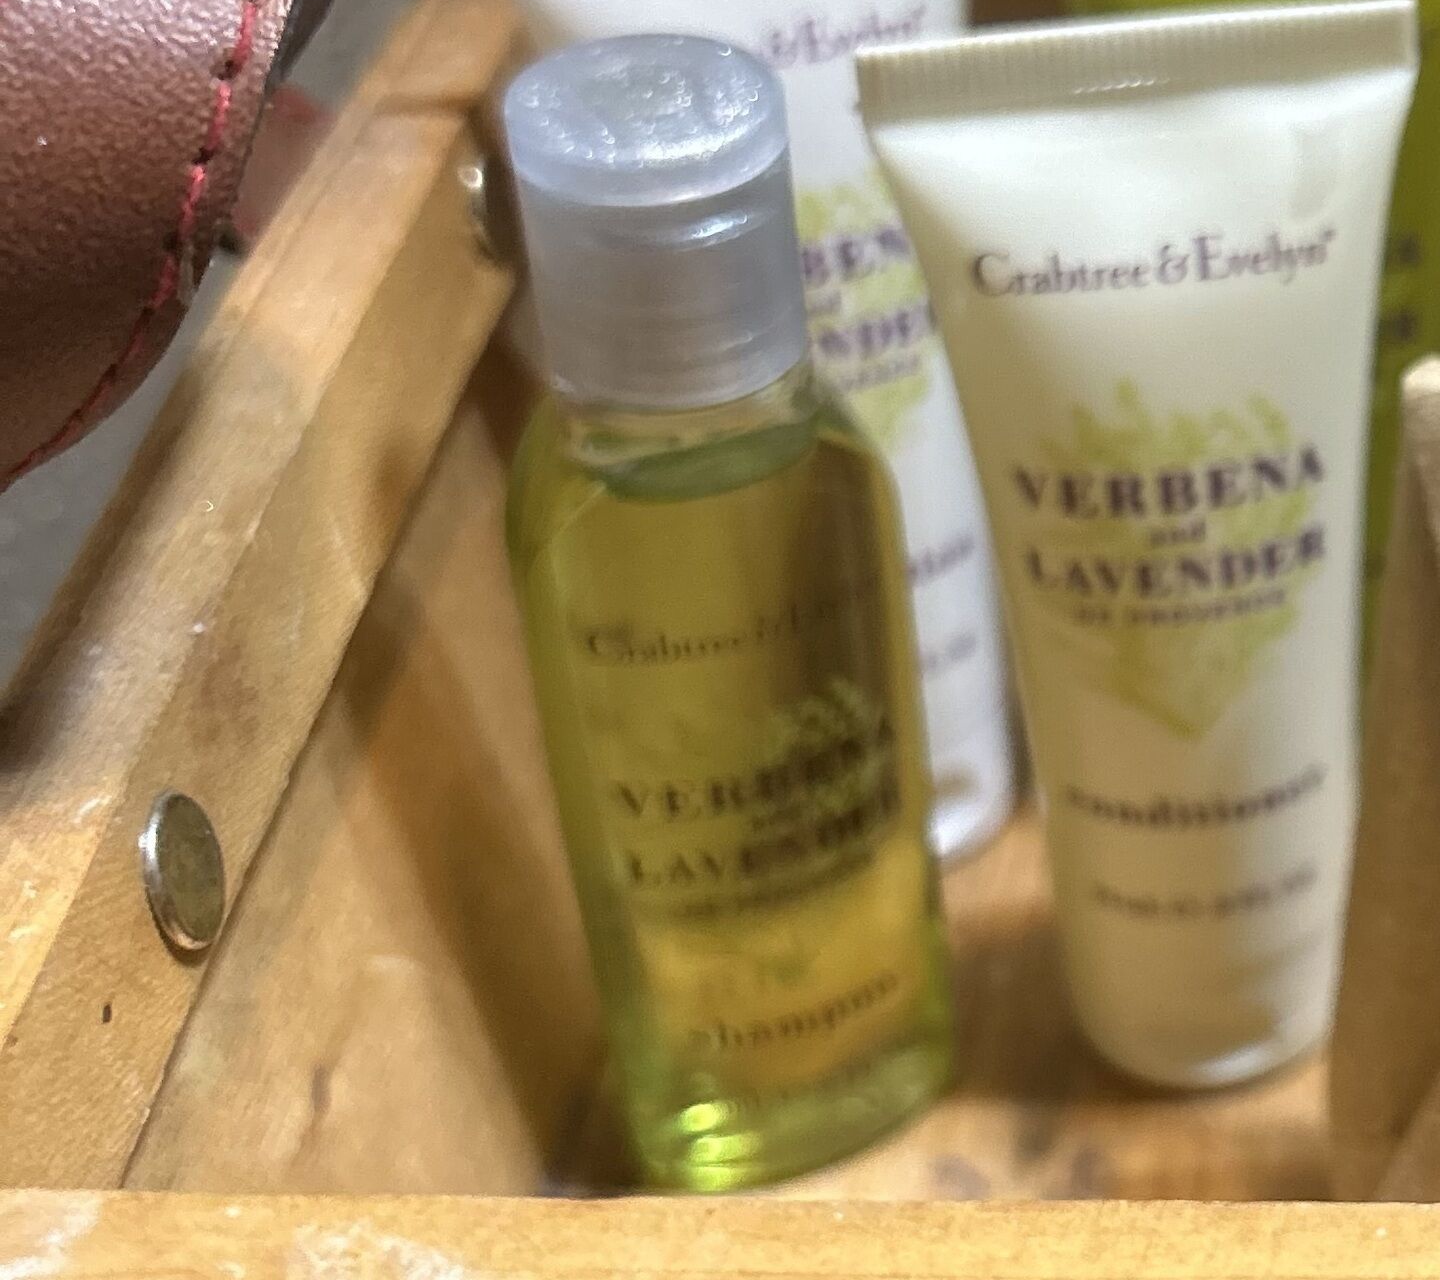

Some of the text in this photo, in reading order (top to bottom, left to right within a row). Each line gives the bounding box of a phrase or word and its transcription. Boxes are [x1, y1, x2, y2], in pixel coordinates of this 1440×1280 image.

[971, 251, 1151, 298] Crabtree
[1192, 230, 1330, 286] Evelyn
[1012, 442, 1326, 519] VERBENA
[1024, 524, 1327, 600] LAVENDER
